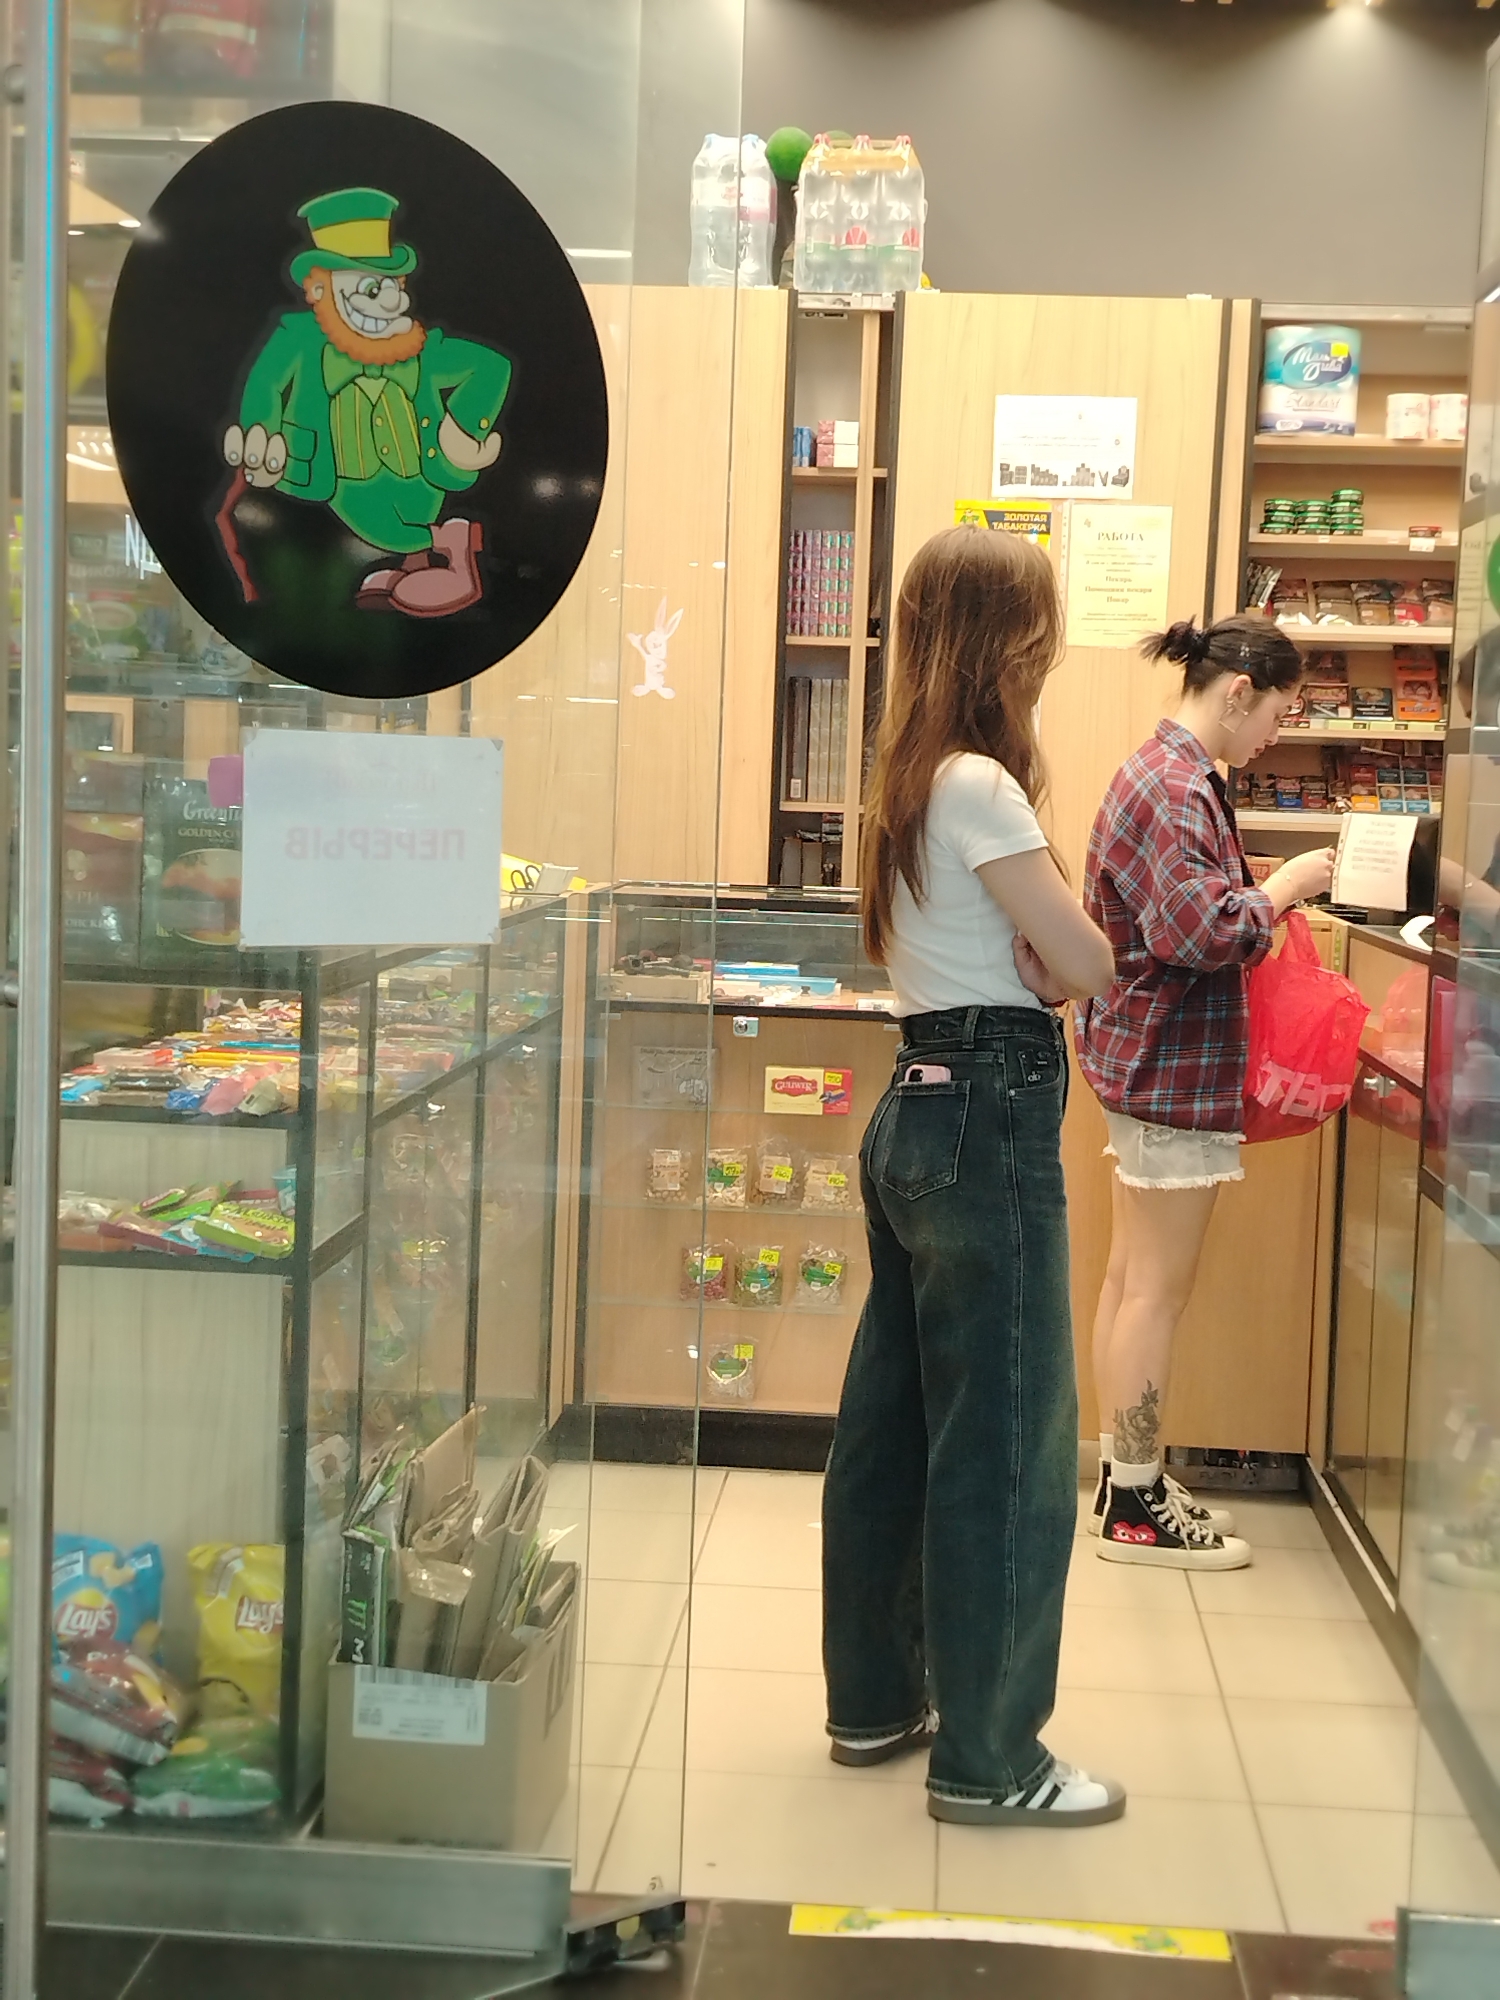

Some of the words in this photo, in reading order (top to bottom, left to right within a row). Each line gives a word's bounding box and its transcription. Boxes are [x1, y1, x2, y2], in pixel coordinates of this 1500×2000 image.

[1003, 512, 1048, 522] ЗОЛОТАЯ
[992, 521, 1047, 532] ТАБАКЕРКА
[1097, 531, 1144, 541] РАБОТА
